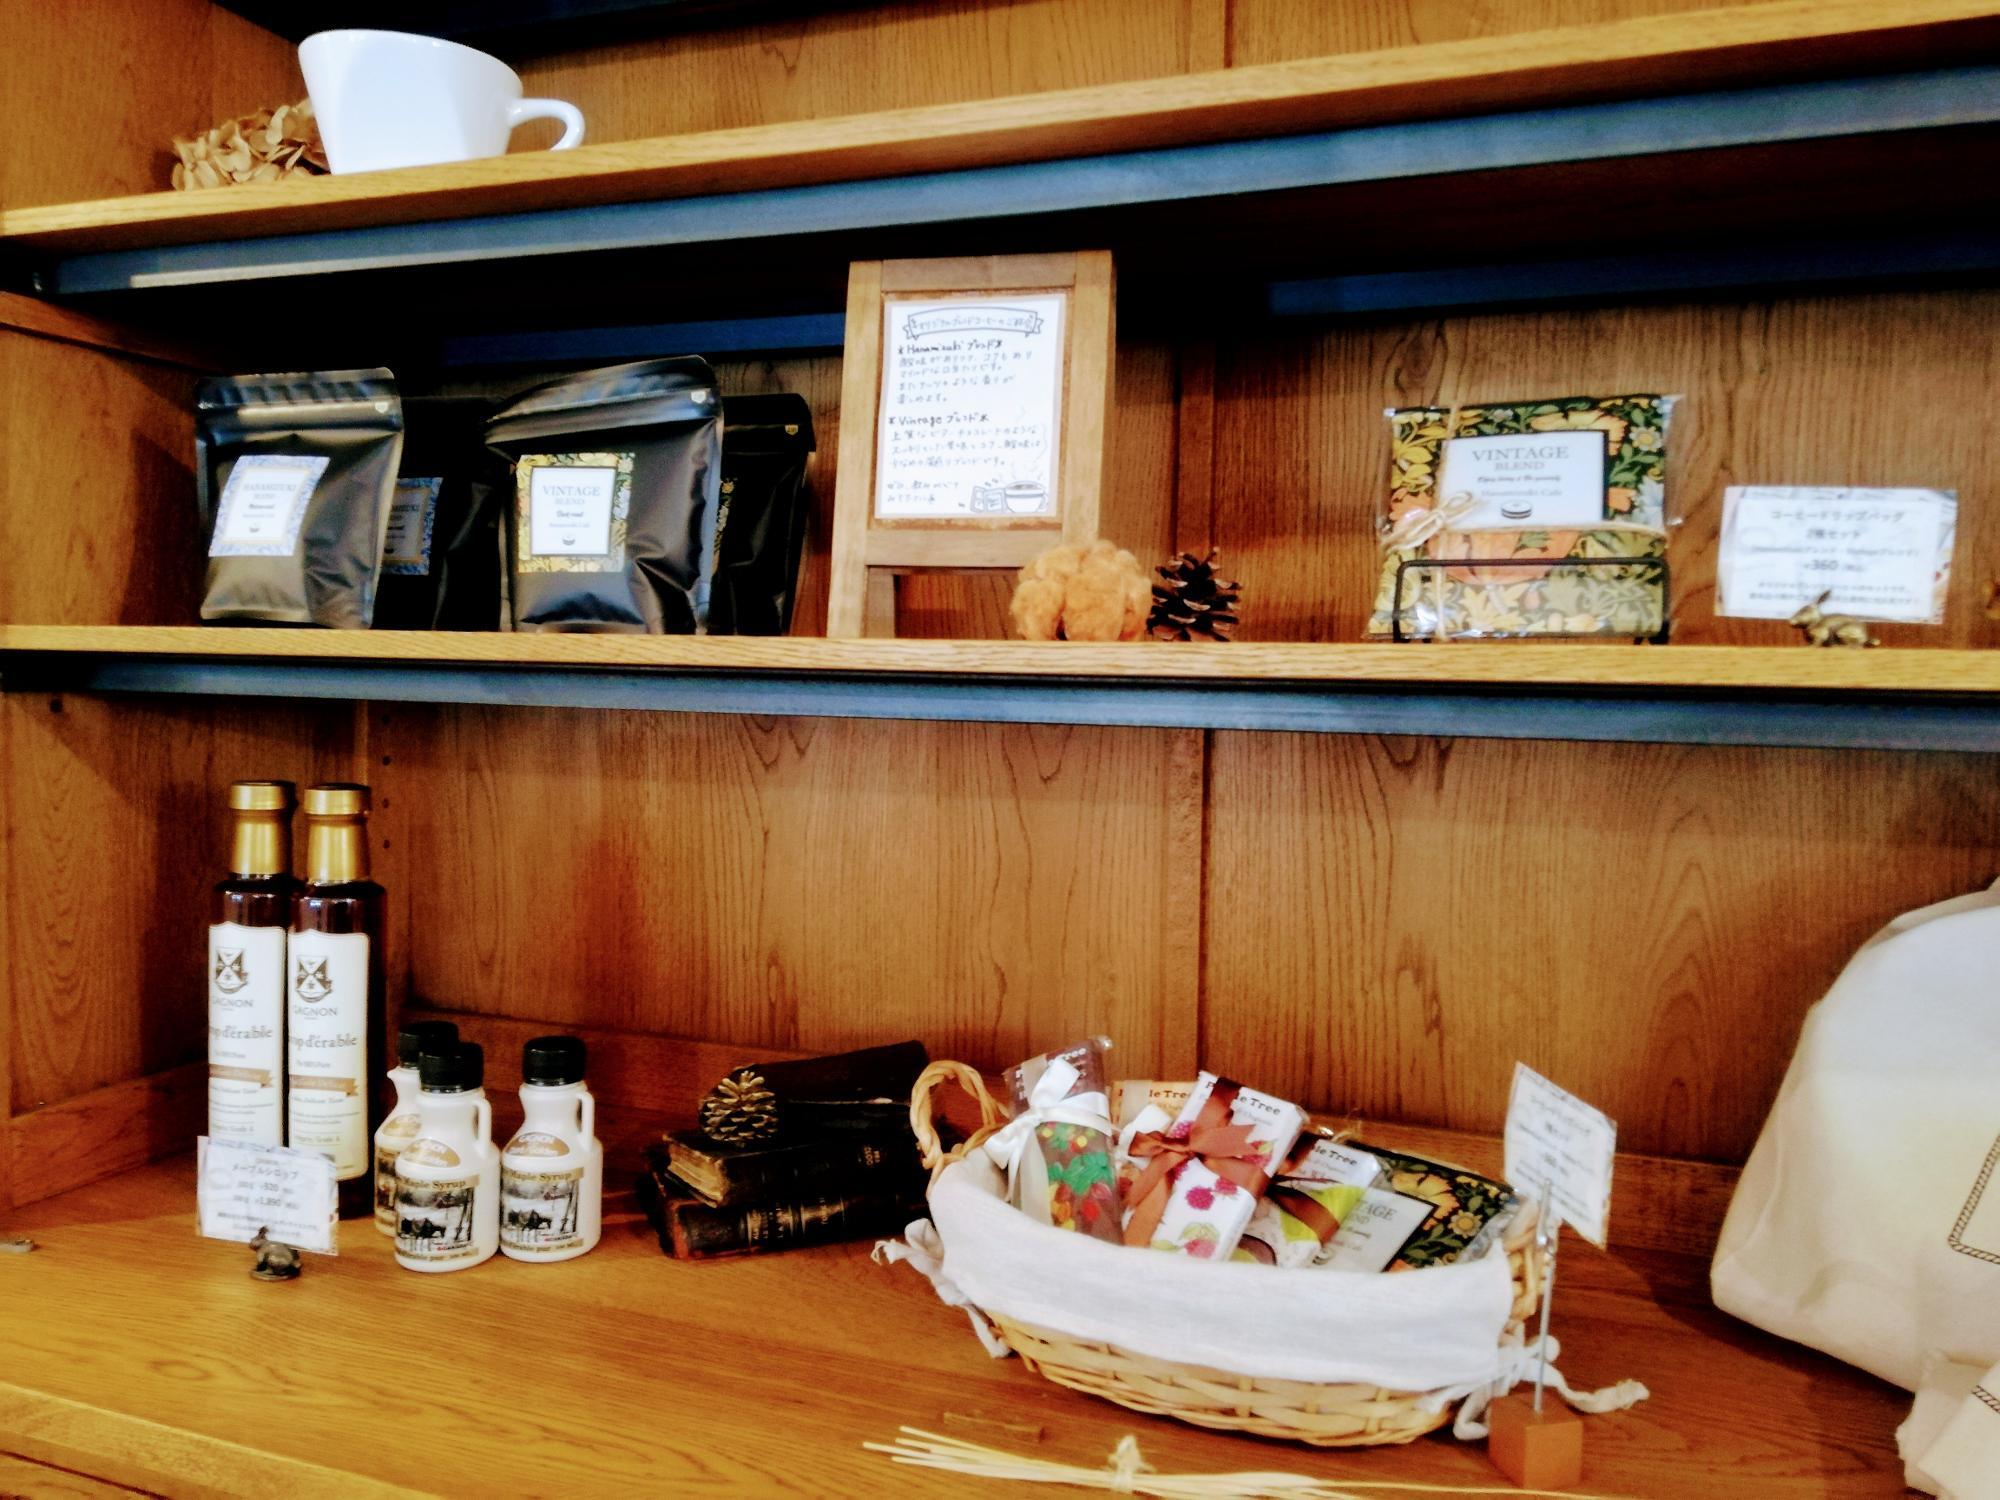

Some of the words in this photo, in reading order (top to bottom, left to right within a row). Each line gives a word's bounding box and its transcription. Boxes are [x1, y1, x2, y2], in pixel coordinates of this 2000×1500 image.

[1472, 446, 1570, 462] VINTAGE
[1495, 461, 1545, 472] BLEND
[542, 486, 601, 497] VINTAGE
[1250, 1097, 1282, 1116] Tree
[1327, 1150, 1358, 1166] Tree
[538, 1172, 573, 1183] Syrup
[431, 1180, 466, 1191] Syrup
[1355, 1202, 1399, 1222] TAGE
